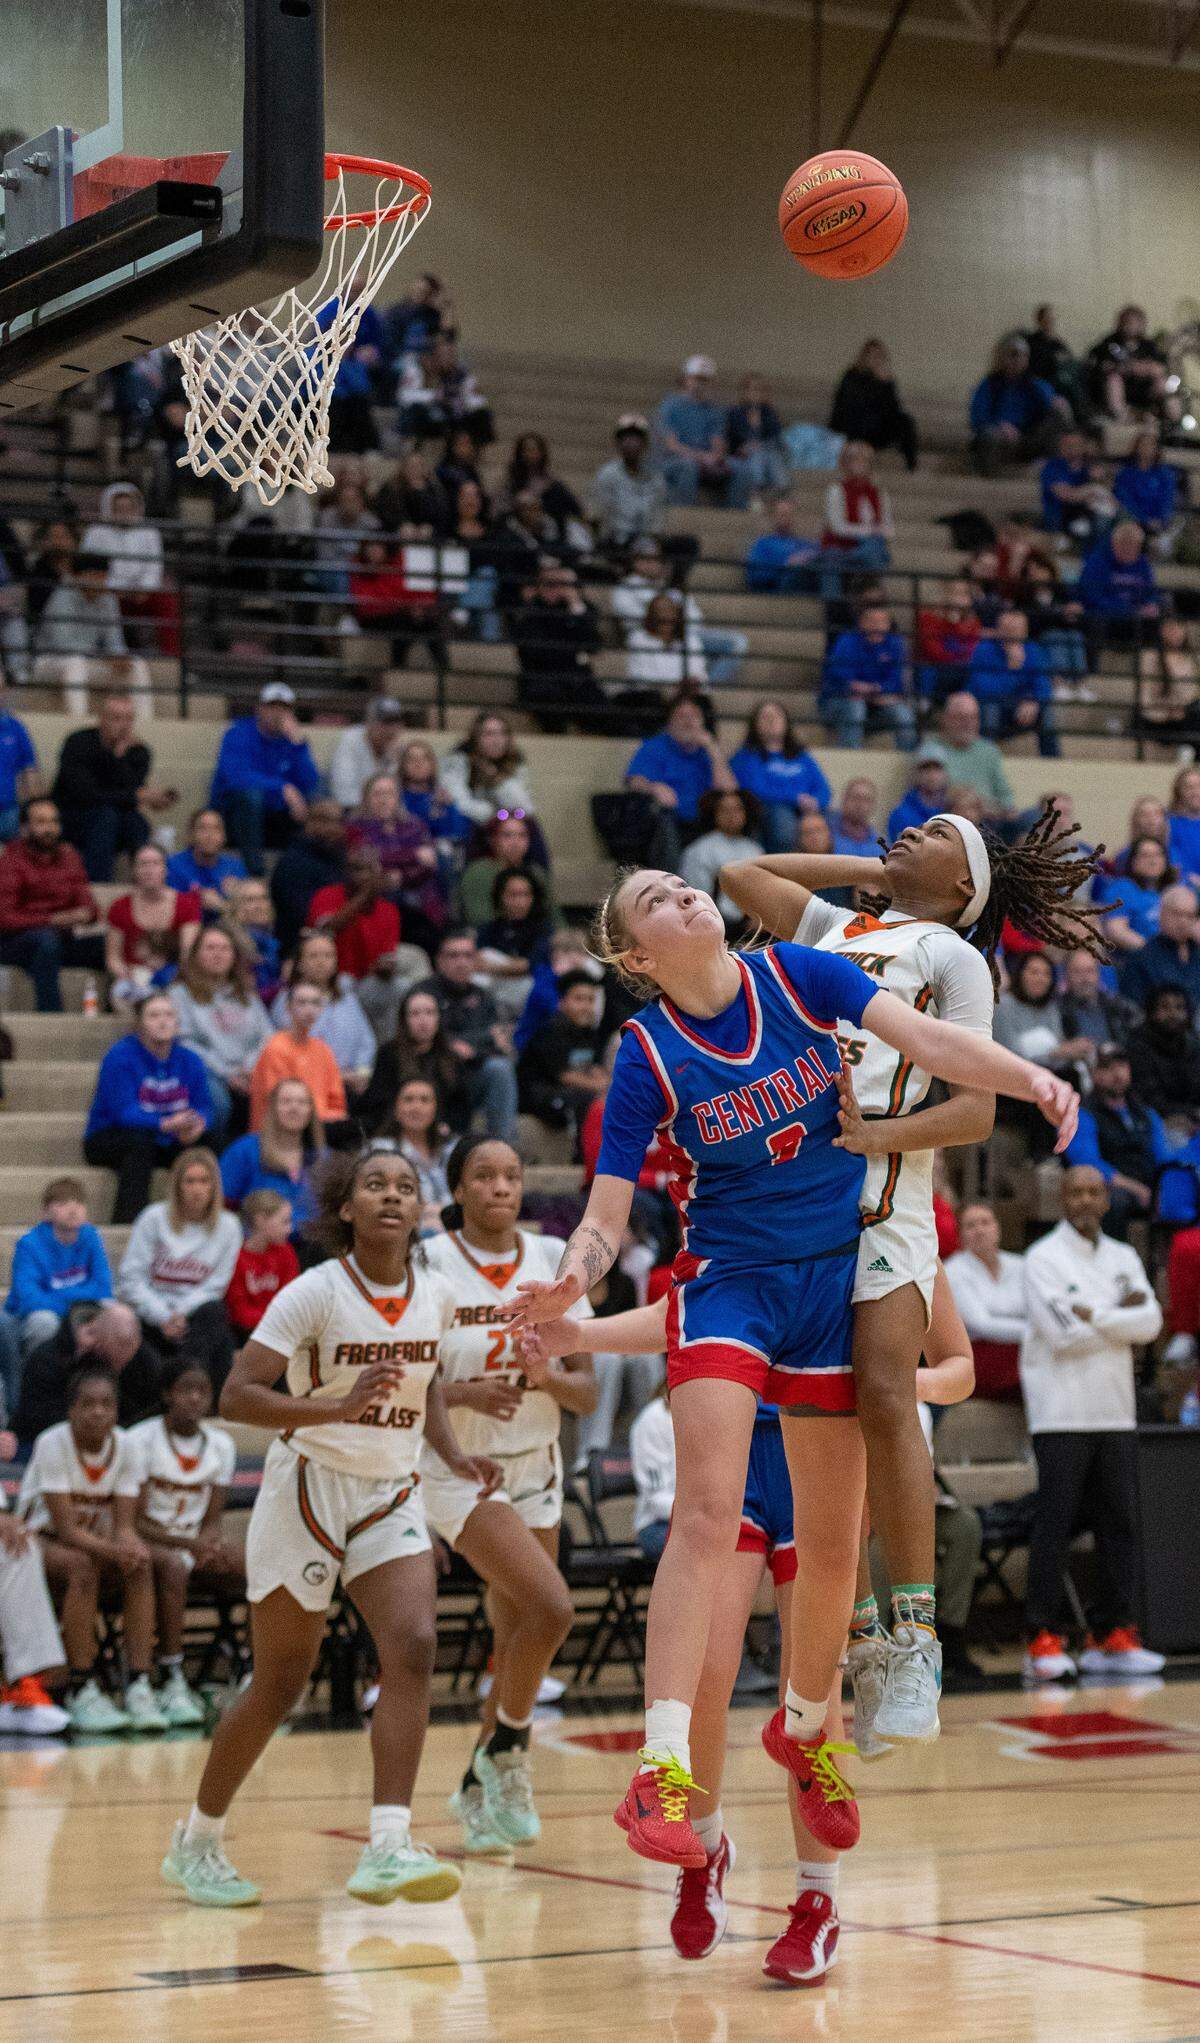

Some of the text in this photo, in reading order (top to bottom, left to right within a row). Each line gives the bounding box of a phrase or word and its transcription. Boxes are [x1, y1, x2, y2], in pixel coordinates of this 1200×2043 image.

[785, 165, 863, 209] SPALDING
[812, 204, 859, 236] KHSAA
[691, 1047, 835, 1145] CENTRAL
[485, 1330, 521, 1371] 2
